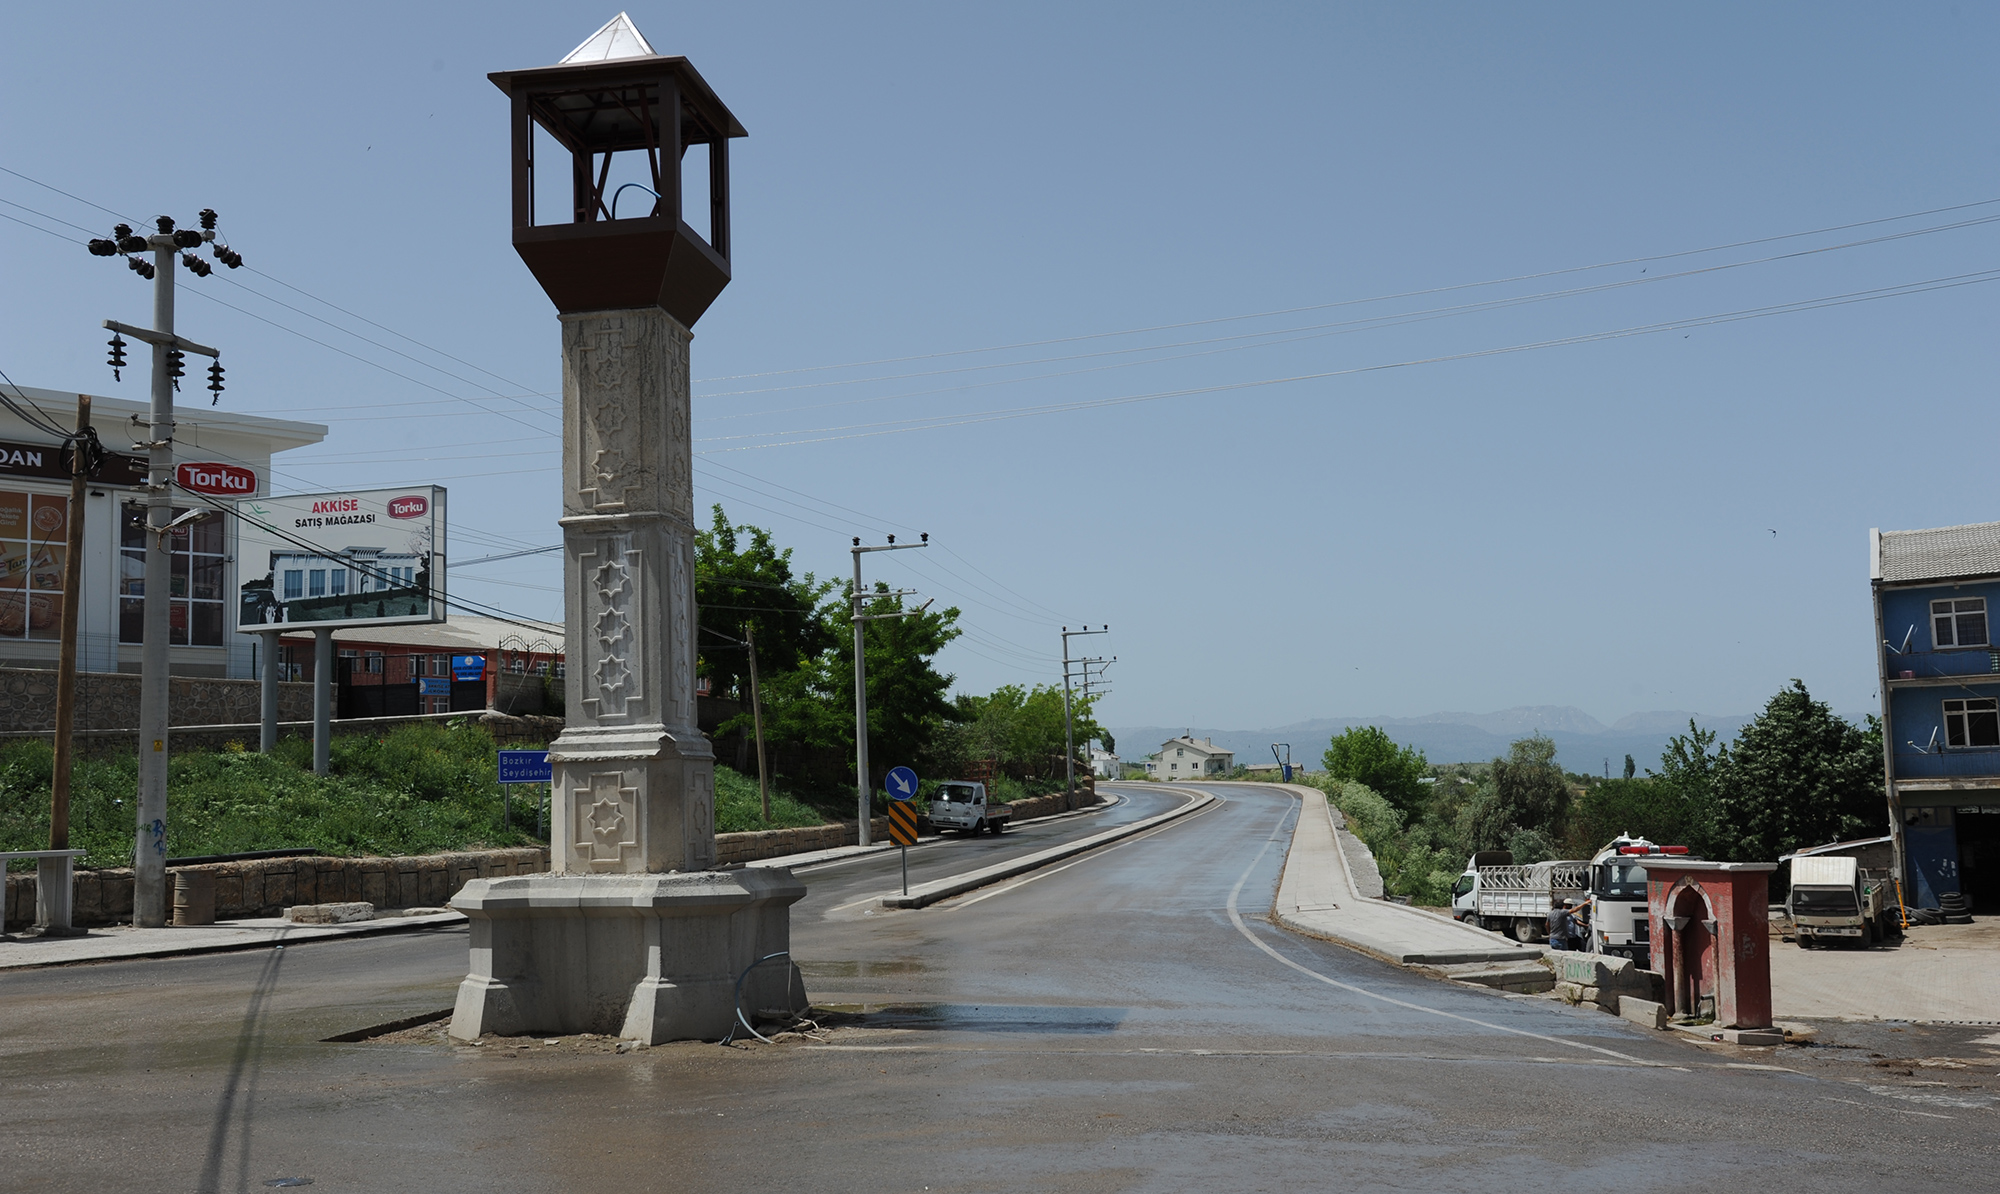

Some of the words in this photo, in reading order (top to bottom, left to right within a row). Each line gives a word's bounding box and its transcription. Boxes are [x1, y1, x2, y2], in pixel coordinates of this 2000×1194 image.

[184, 467, 248, 489] Torku
[312, 497, 358, 513] AKKİSE
[392, 502, 423, 514] Torku
[295, 518, 322, 529] SATIŞ
[325, 514, 376, 526] MAĞAZASI
[502, 757, 532, 765] Bozkır
